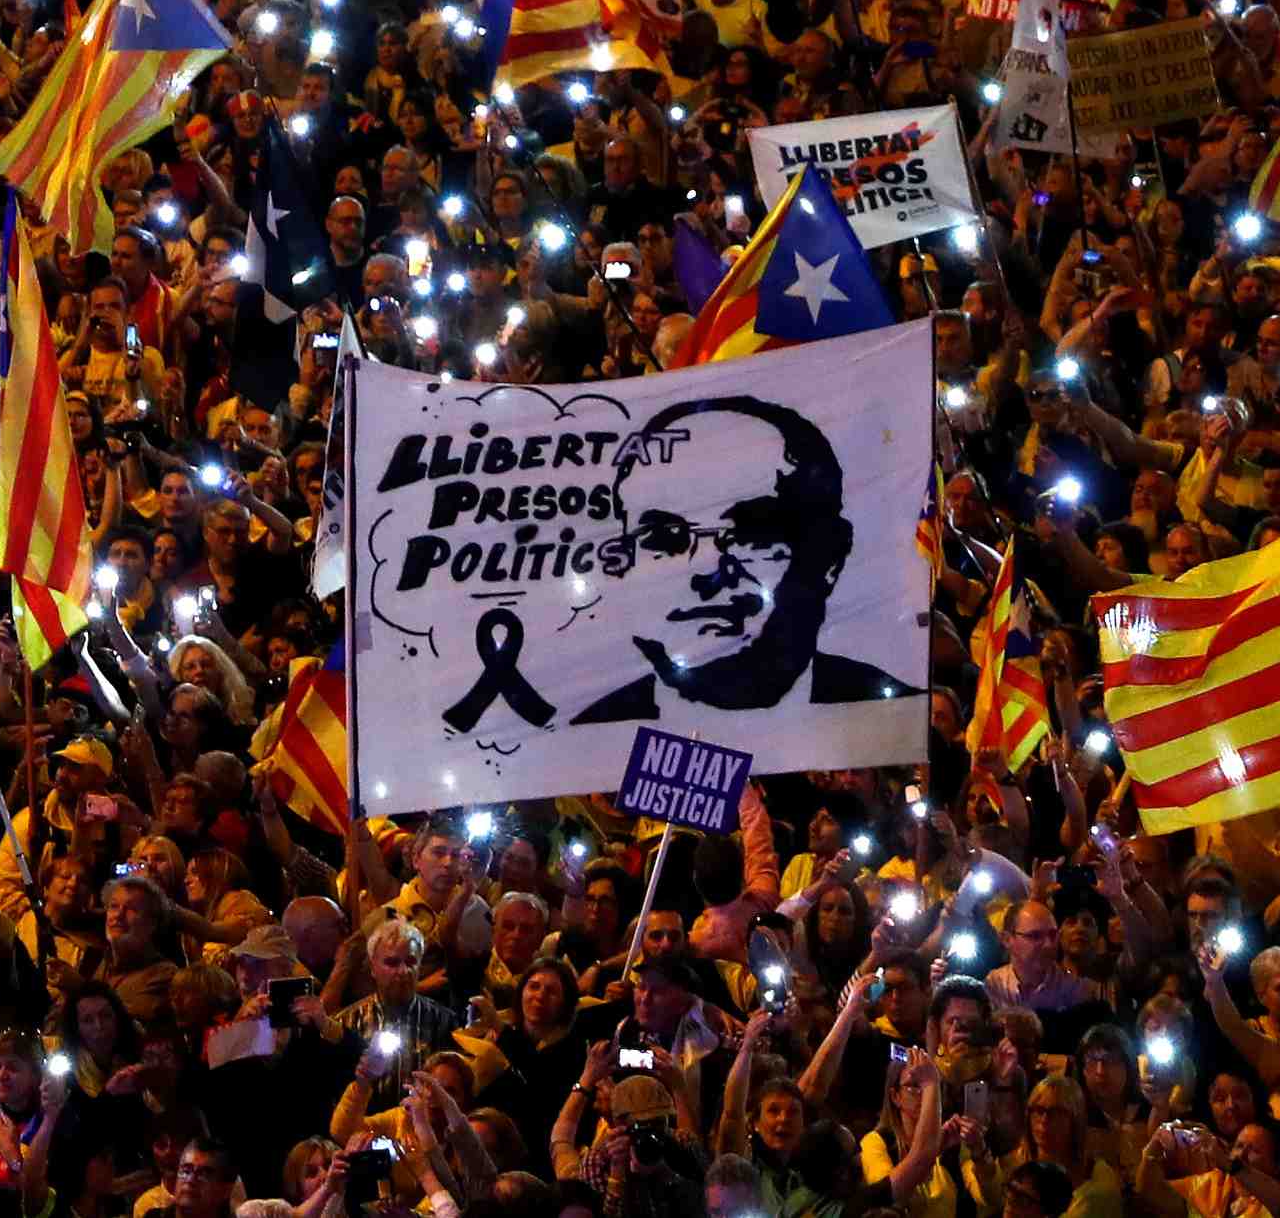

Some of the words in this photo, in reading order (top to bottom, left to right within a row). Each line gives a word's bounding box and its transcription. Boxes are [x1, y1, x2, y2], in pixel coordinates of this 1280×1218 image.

[778, 129, 920, 170] LLIBERTAT
[428, 481, 613, 530] PRESOS
[640, 735, 684, 779] NO
[683, 746, 745, 793] HAY
[623, 778, 727, 830] JUSTÍCIA
